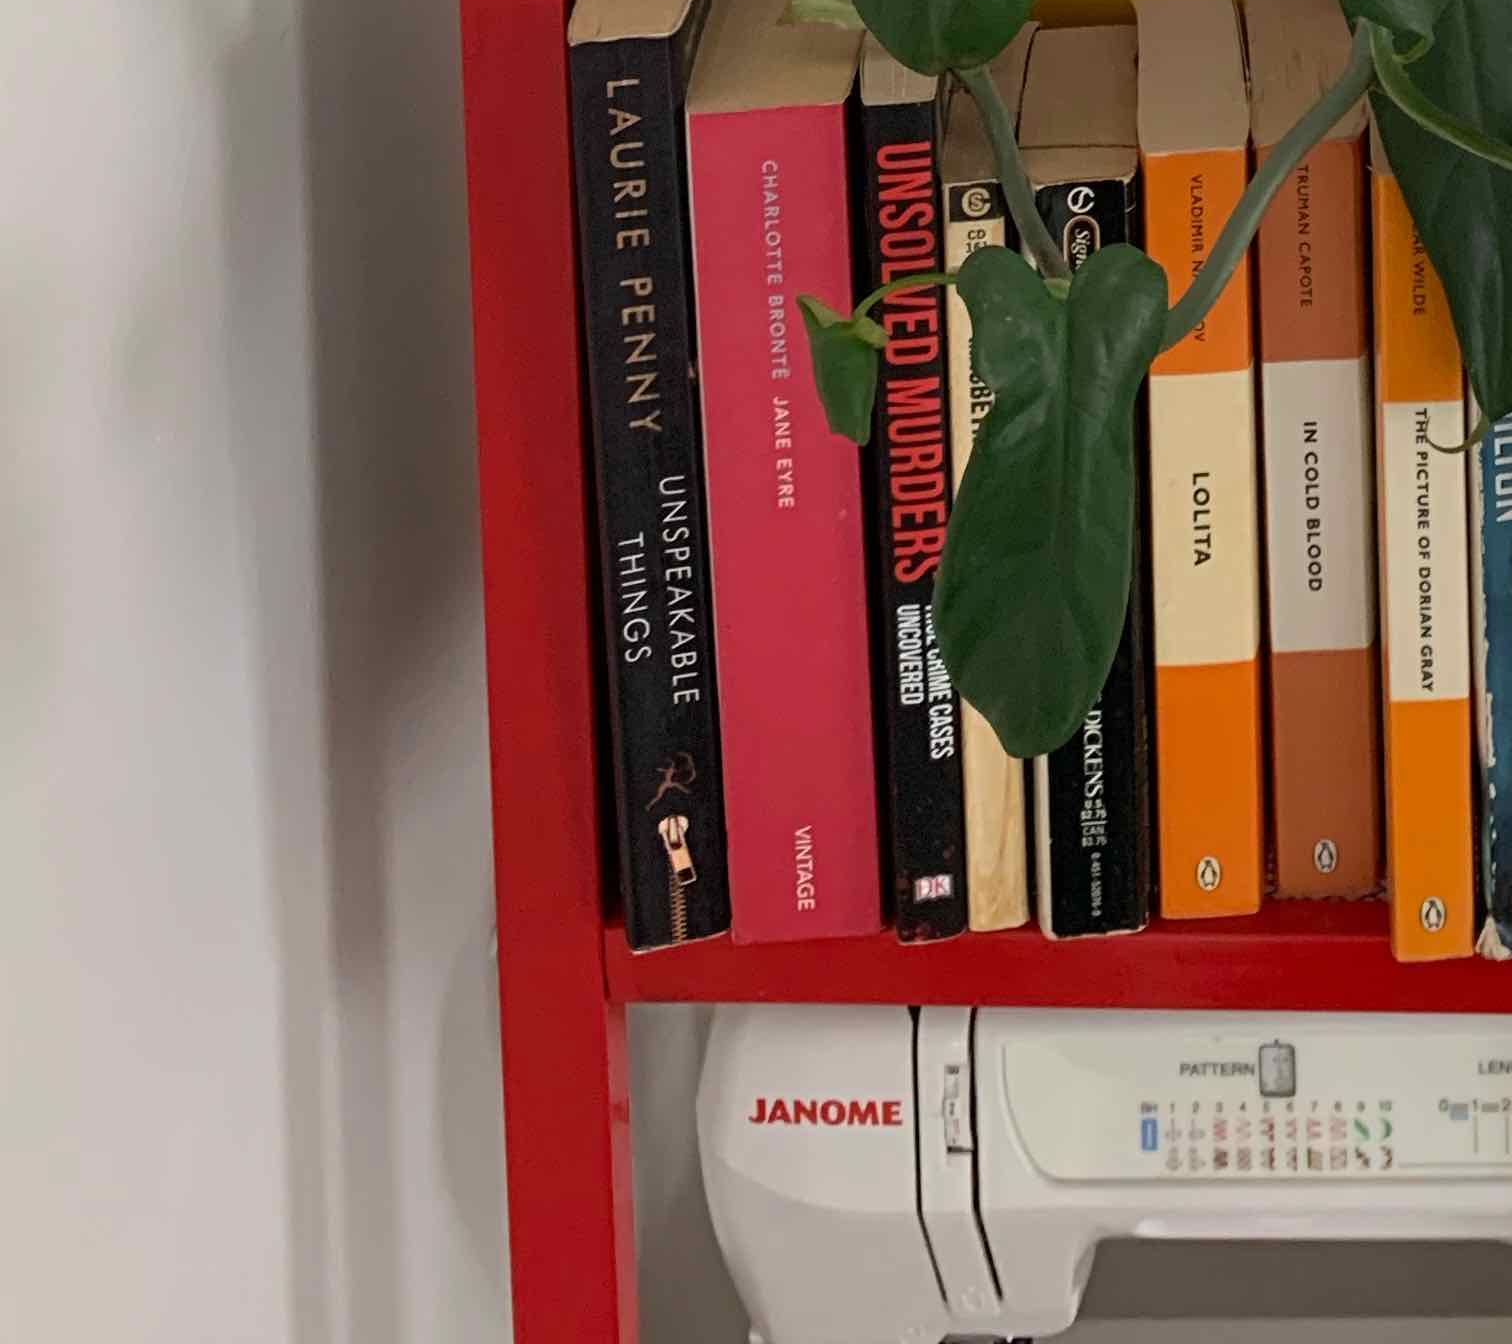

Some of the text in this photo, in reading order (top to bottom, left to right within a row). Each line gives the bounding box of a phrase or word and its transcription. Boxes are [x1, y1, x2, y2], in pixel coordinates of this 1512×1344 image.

[605, 78, 664, 435] LAURIE PENNY
[761, 159, 785, 285] CHARLOTTE
[967, 228, 987, 240] CD
[1071, 227, 1092, 271] Sign
[1190, 173, 1205, 254] VLADIMIR
[1296, 163, 1314, 308] TRUMAN CAPOTE
[1412, 261, 1426, 316] WILDE
[876, 140, 948, 584] UNSOLVED MURDERS
[772, 394, 797, 511] JANE EYRE
[1192, 470, 1212, 568] LOLITA
[1303, 420, 1323, 593] IN COLD BLOOD
[1415, 407, 1435, 693] THE PICTURE OF DORIAN GRAY
[617, 530, 654, 664] THINGS
[658, 474, 701, 706] UNSPEAKABLE
[896, 603, 925, 706] UNCOVERED
[928, 703, 956, 760] CASES
[1083, 709, 1105, 799] DICKENS
[794, 824, 817, 912] VINTAGE
[748, 1097, 904, 1126] JANOME
[1179, 1062, 1256, 1077] PATTERN
